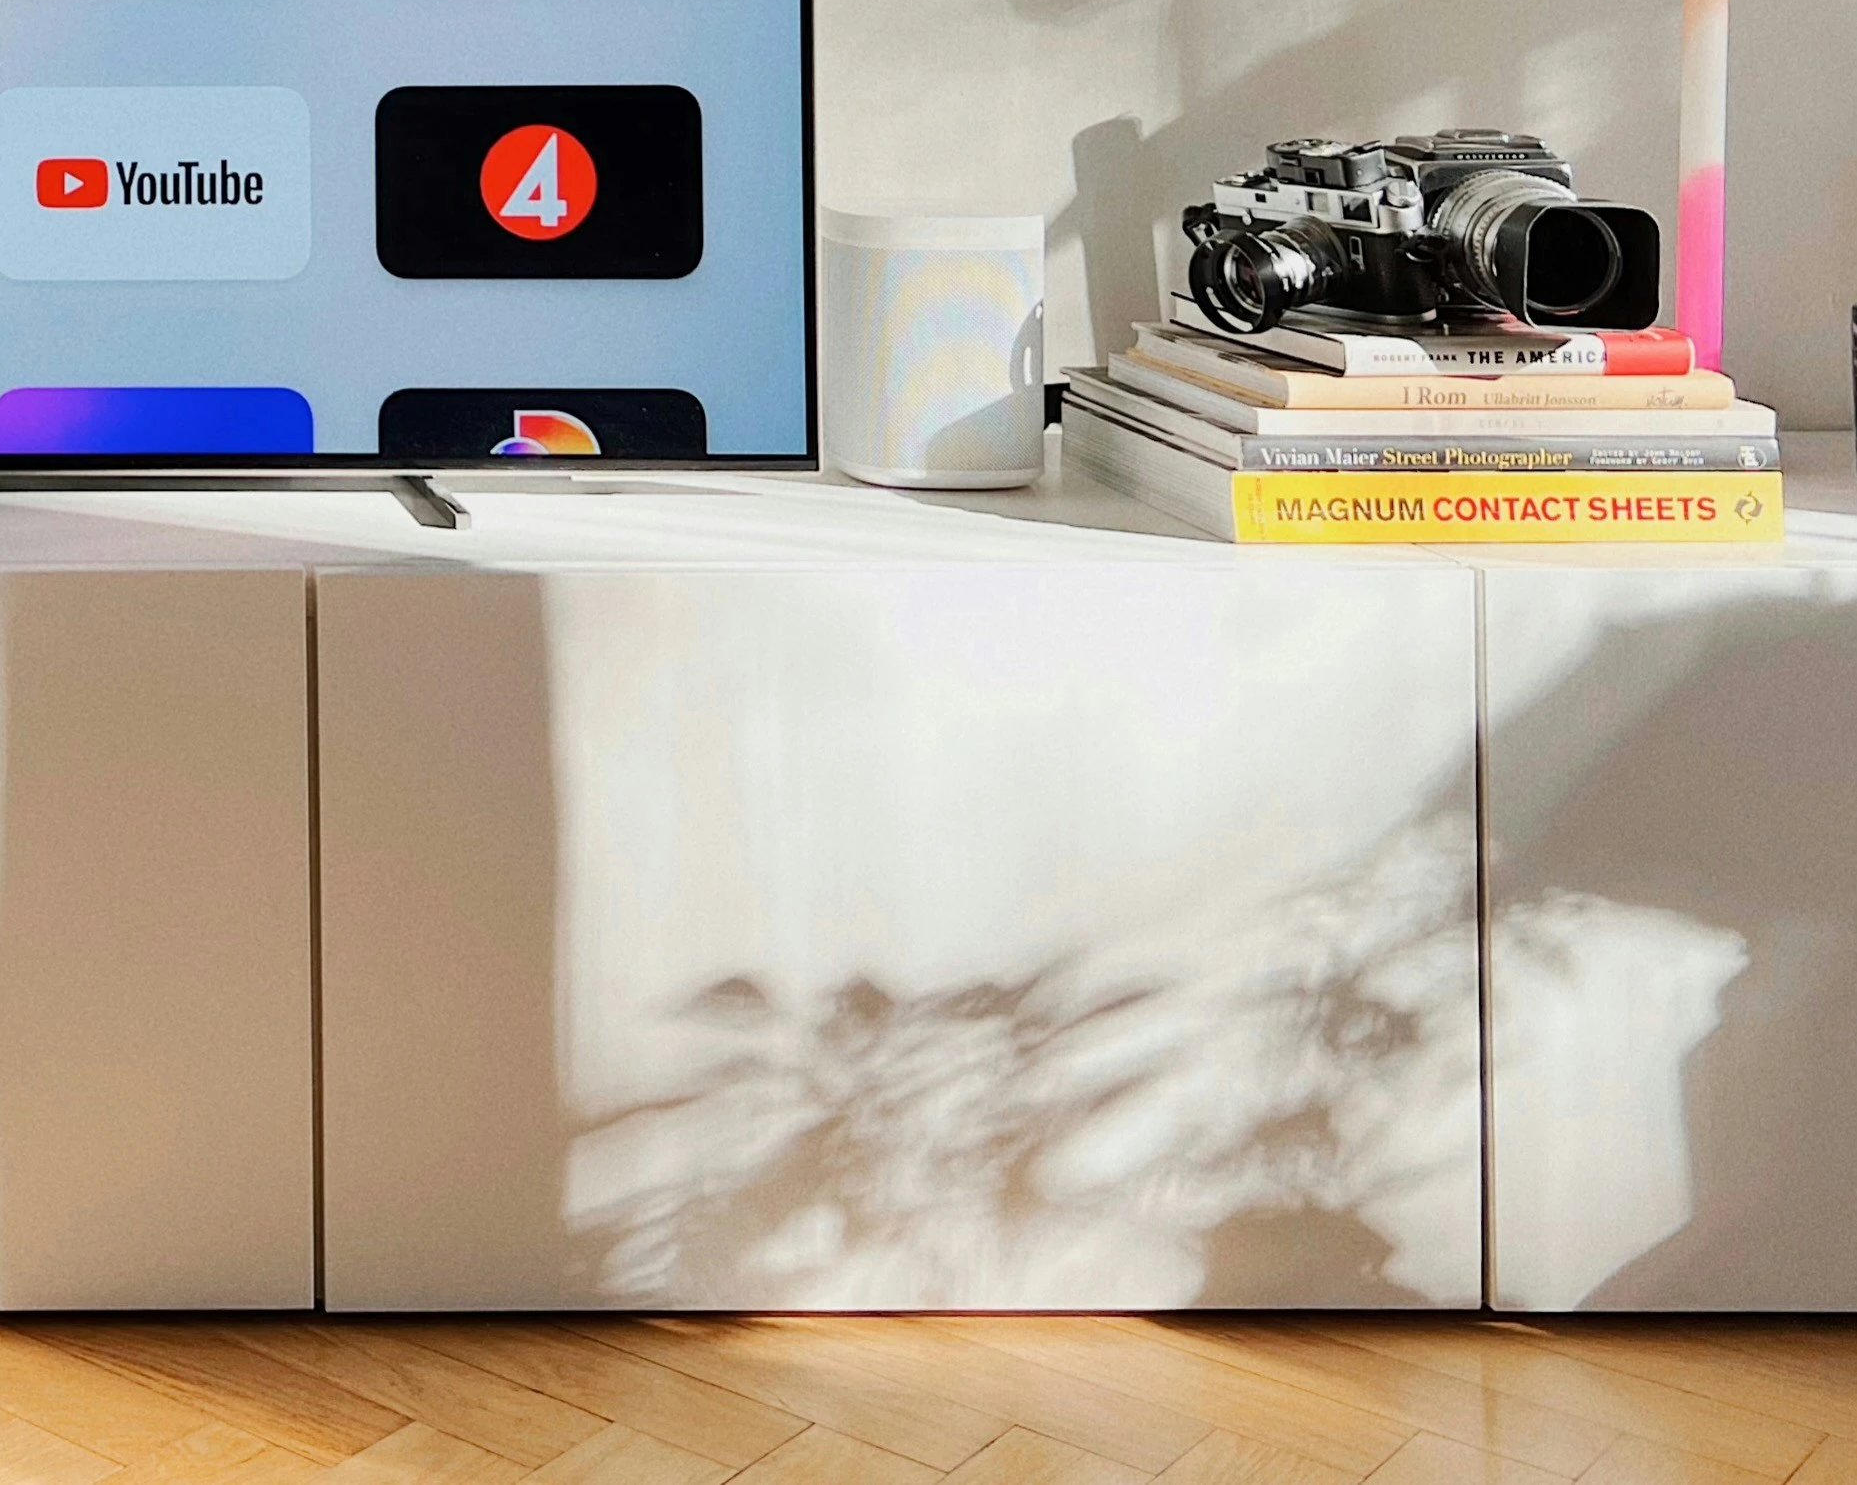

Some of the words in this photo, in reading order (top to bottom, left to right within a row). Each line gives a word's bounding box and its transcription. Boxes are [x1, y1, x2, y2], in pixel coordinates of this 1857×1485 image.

[116, 160, 264, 206] YouTube
[499, 133, 568, 227] 4
[1467, 351, 1504, 364] THE
[1403, 386, 1410, 404] I
[1418, 386, 1467, 405] Rom
[1484, 393, 1540, 405] Ullabritt
[1544, 394, 1597, 407] Jonsson
[1261, 447, 1319, 465] Vivian
[1325, 447, 1379, 465] Maier
[1382, 447, 1438, 465] Street
[1445, 447, 1573, 469] Photographer
[1276, 497, 1425, 521] MAGNUM
[1433, 496, 1580, 521] CONTACT
[1588, 496, 1716, 521] SHEETS
